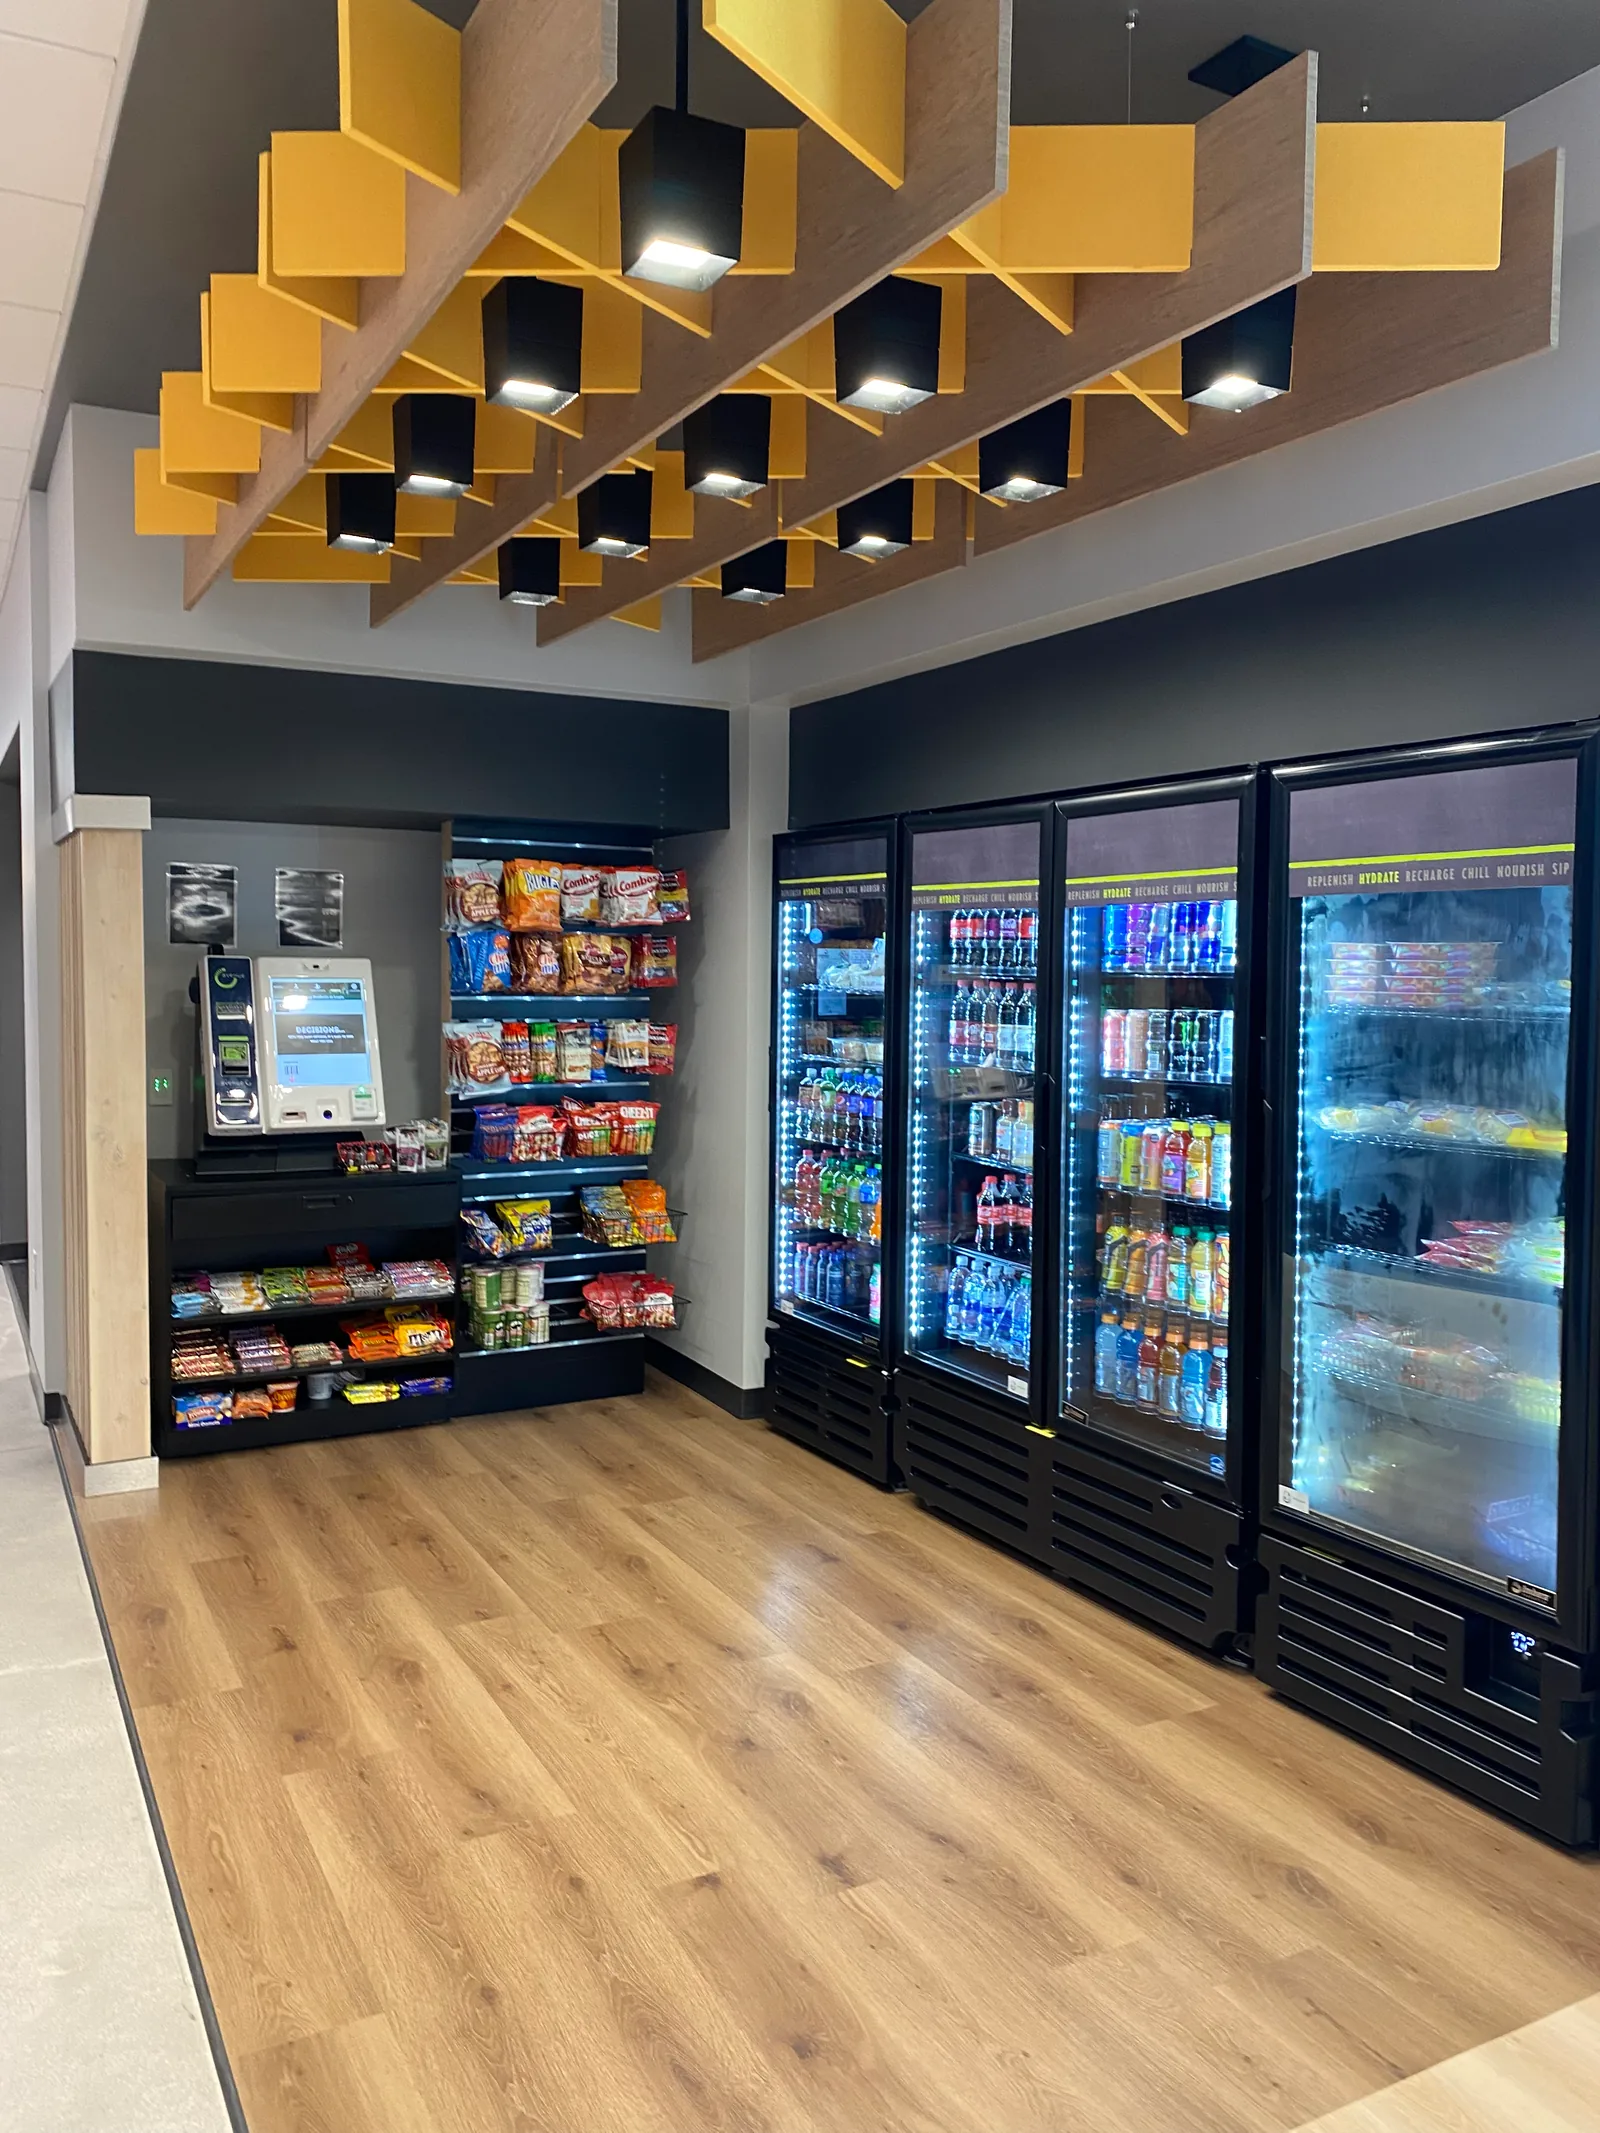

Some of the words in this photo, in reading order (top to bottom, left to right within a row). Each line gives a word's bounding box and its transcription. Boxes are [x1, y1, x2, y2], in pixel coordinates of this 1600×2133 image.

[619, 874, 657, 892] Combos
[1307, 874, 1353, 887] REPLENISH
[1358, 871, 1400, 885] HYDRATE
[1405, 867, 1455, 882] RECHARGE
[1461, 866, 1490, 879] CHILL
[1496, 863, 1545, 878] NOURISH
[1552, 862, 1570, 875] SIP
[1068, 889, 1100, 901] REPLENISH
[1102, 887, 1132, 899] HYDRATE
[1135, 885, 1169, 897] RECHARGE
[1172, 883, 1192, 895] CHILL
[1196, 881, 1229, 894] NOURISH
